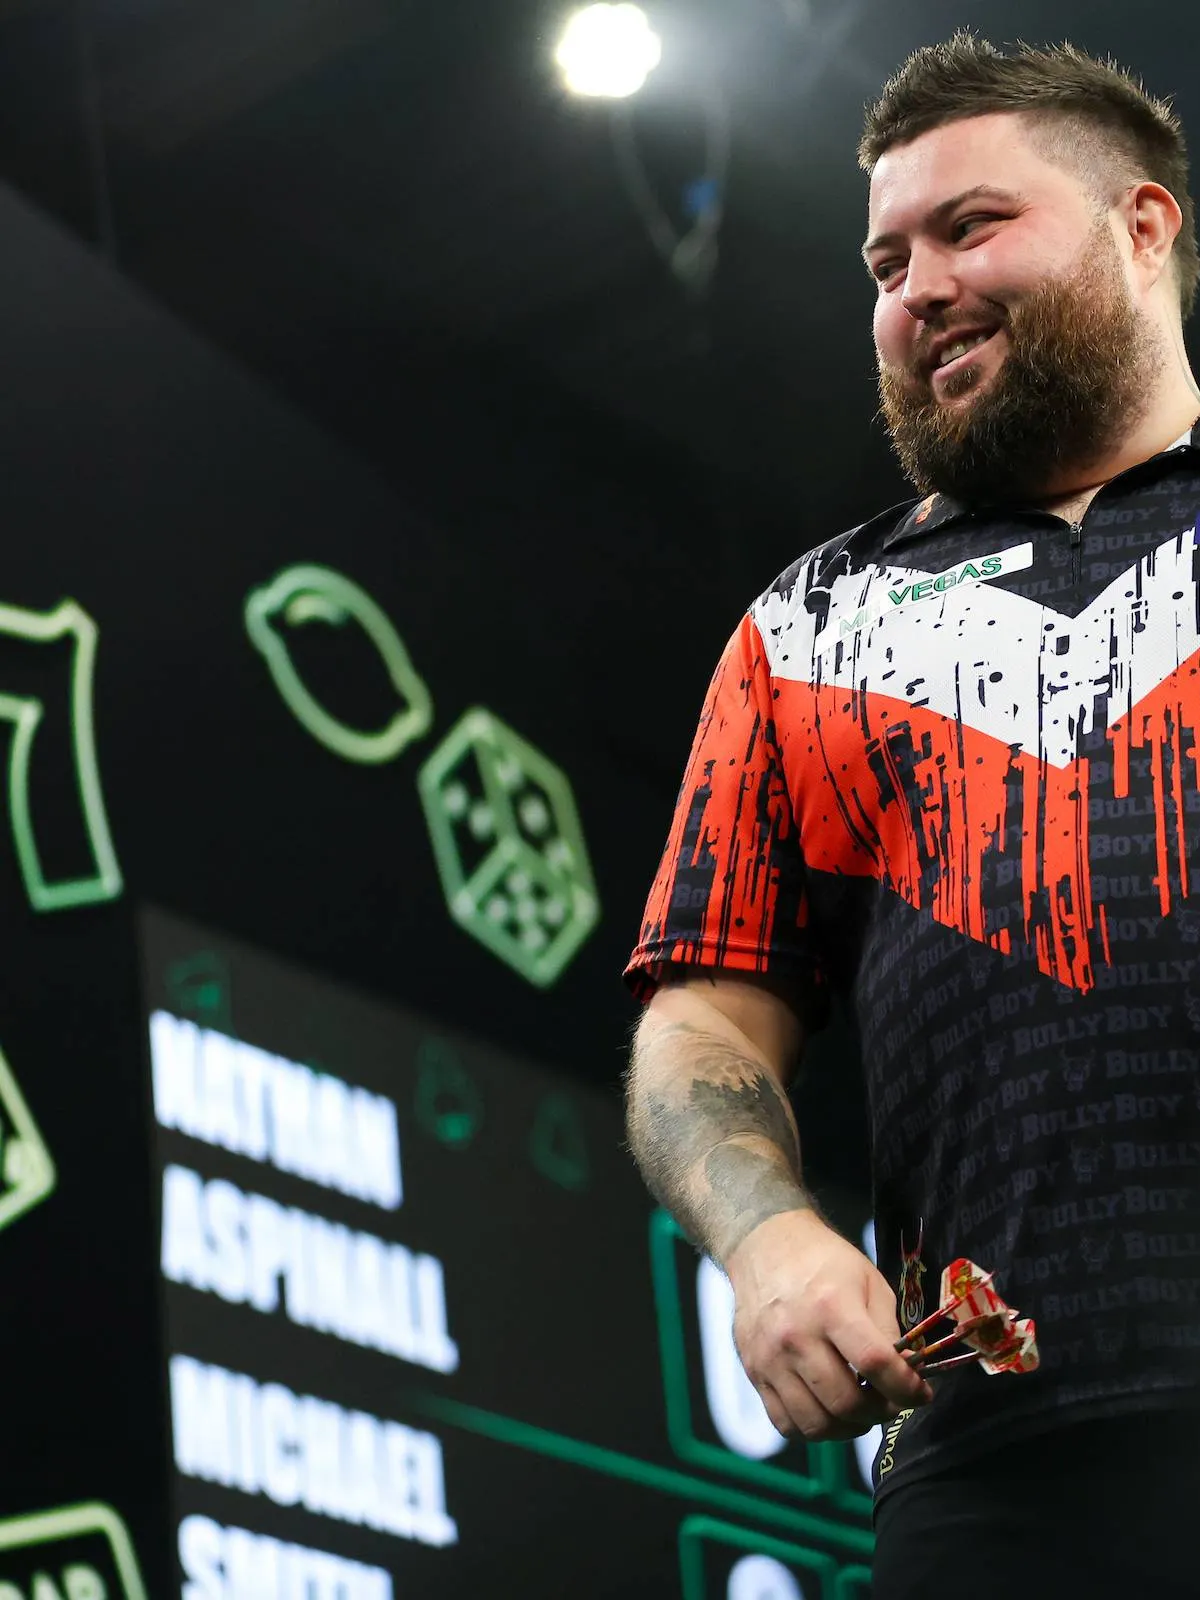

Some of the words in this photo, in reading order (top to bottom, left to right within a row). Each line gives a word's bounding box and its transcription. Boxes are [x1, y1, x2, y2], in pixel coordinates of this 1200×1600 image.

[888, 556, 1002, 606] VEGAS
[160, 1163, 460, 1377] ASPINALL
[169, 1352, 458, 1548] MICHAEL
